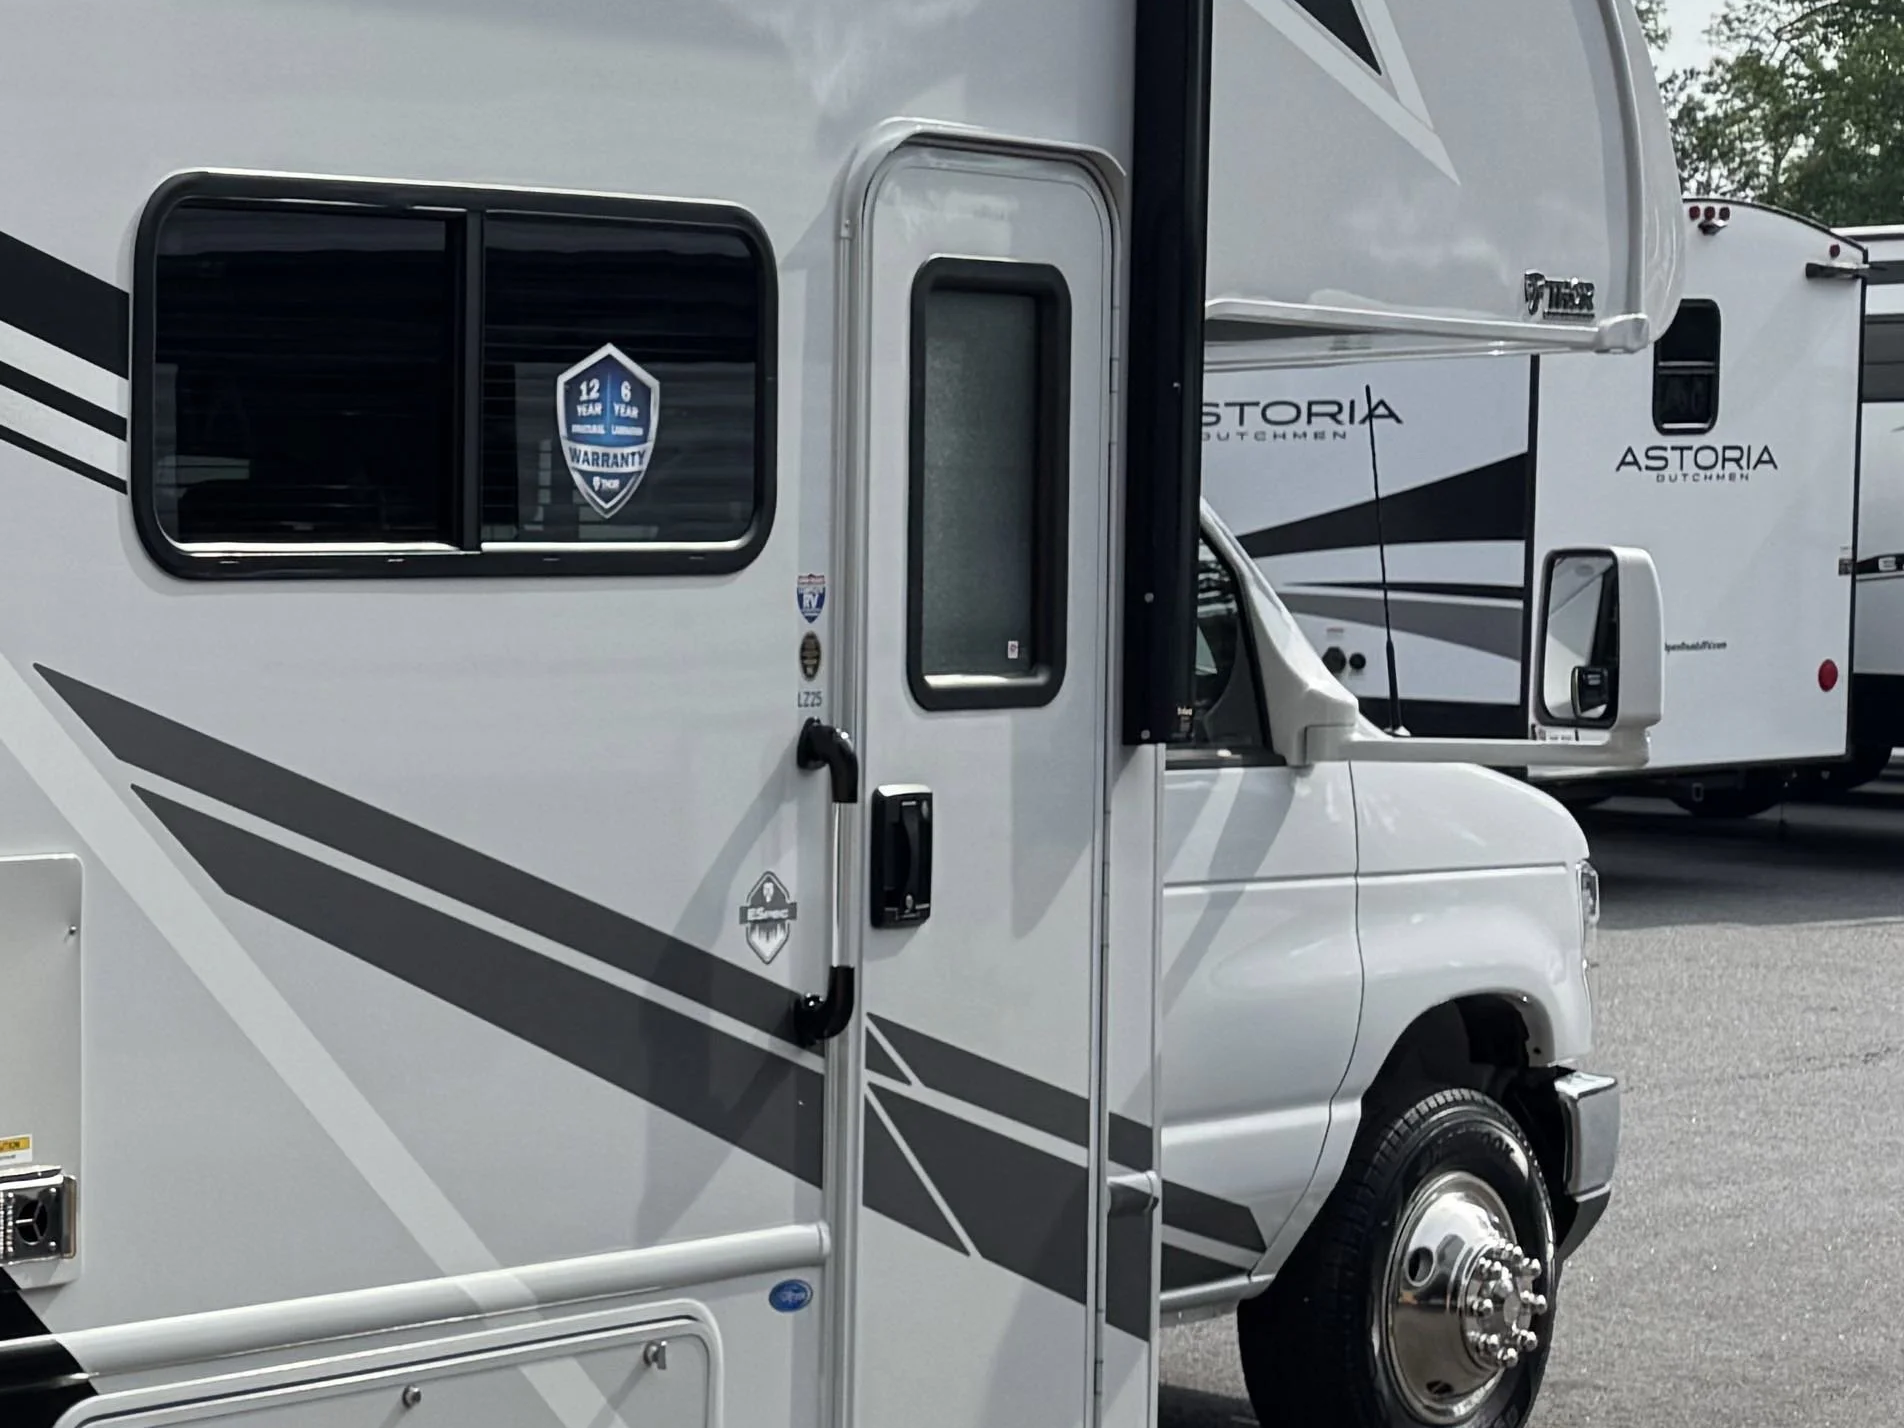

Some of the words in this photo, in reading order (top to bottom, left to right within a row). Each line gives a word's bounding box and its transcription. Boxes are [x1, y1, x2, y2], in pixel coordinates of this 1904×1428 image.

[579, 378, 601, 401] 12
[620, 380, 631, 403] 6
[576, 402, 603, 417] YEAR
[613, 402, 639, 419] YEAR
[1202, 399, 1404, 427] STORIA
[568, 446, 647, 469] WARRANTY
[1615, 444, 1779, 472] ASTORIA
[1656, 472, 1750, 483] DUTCHMEN
